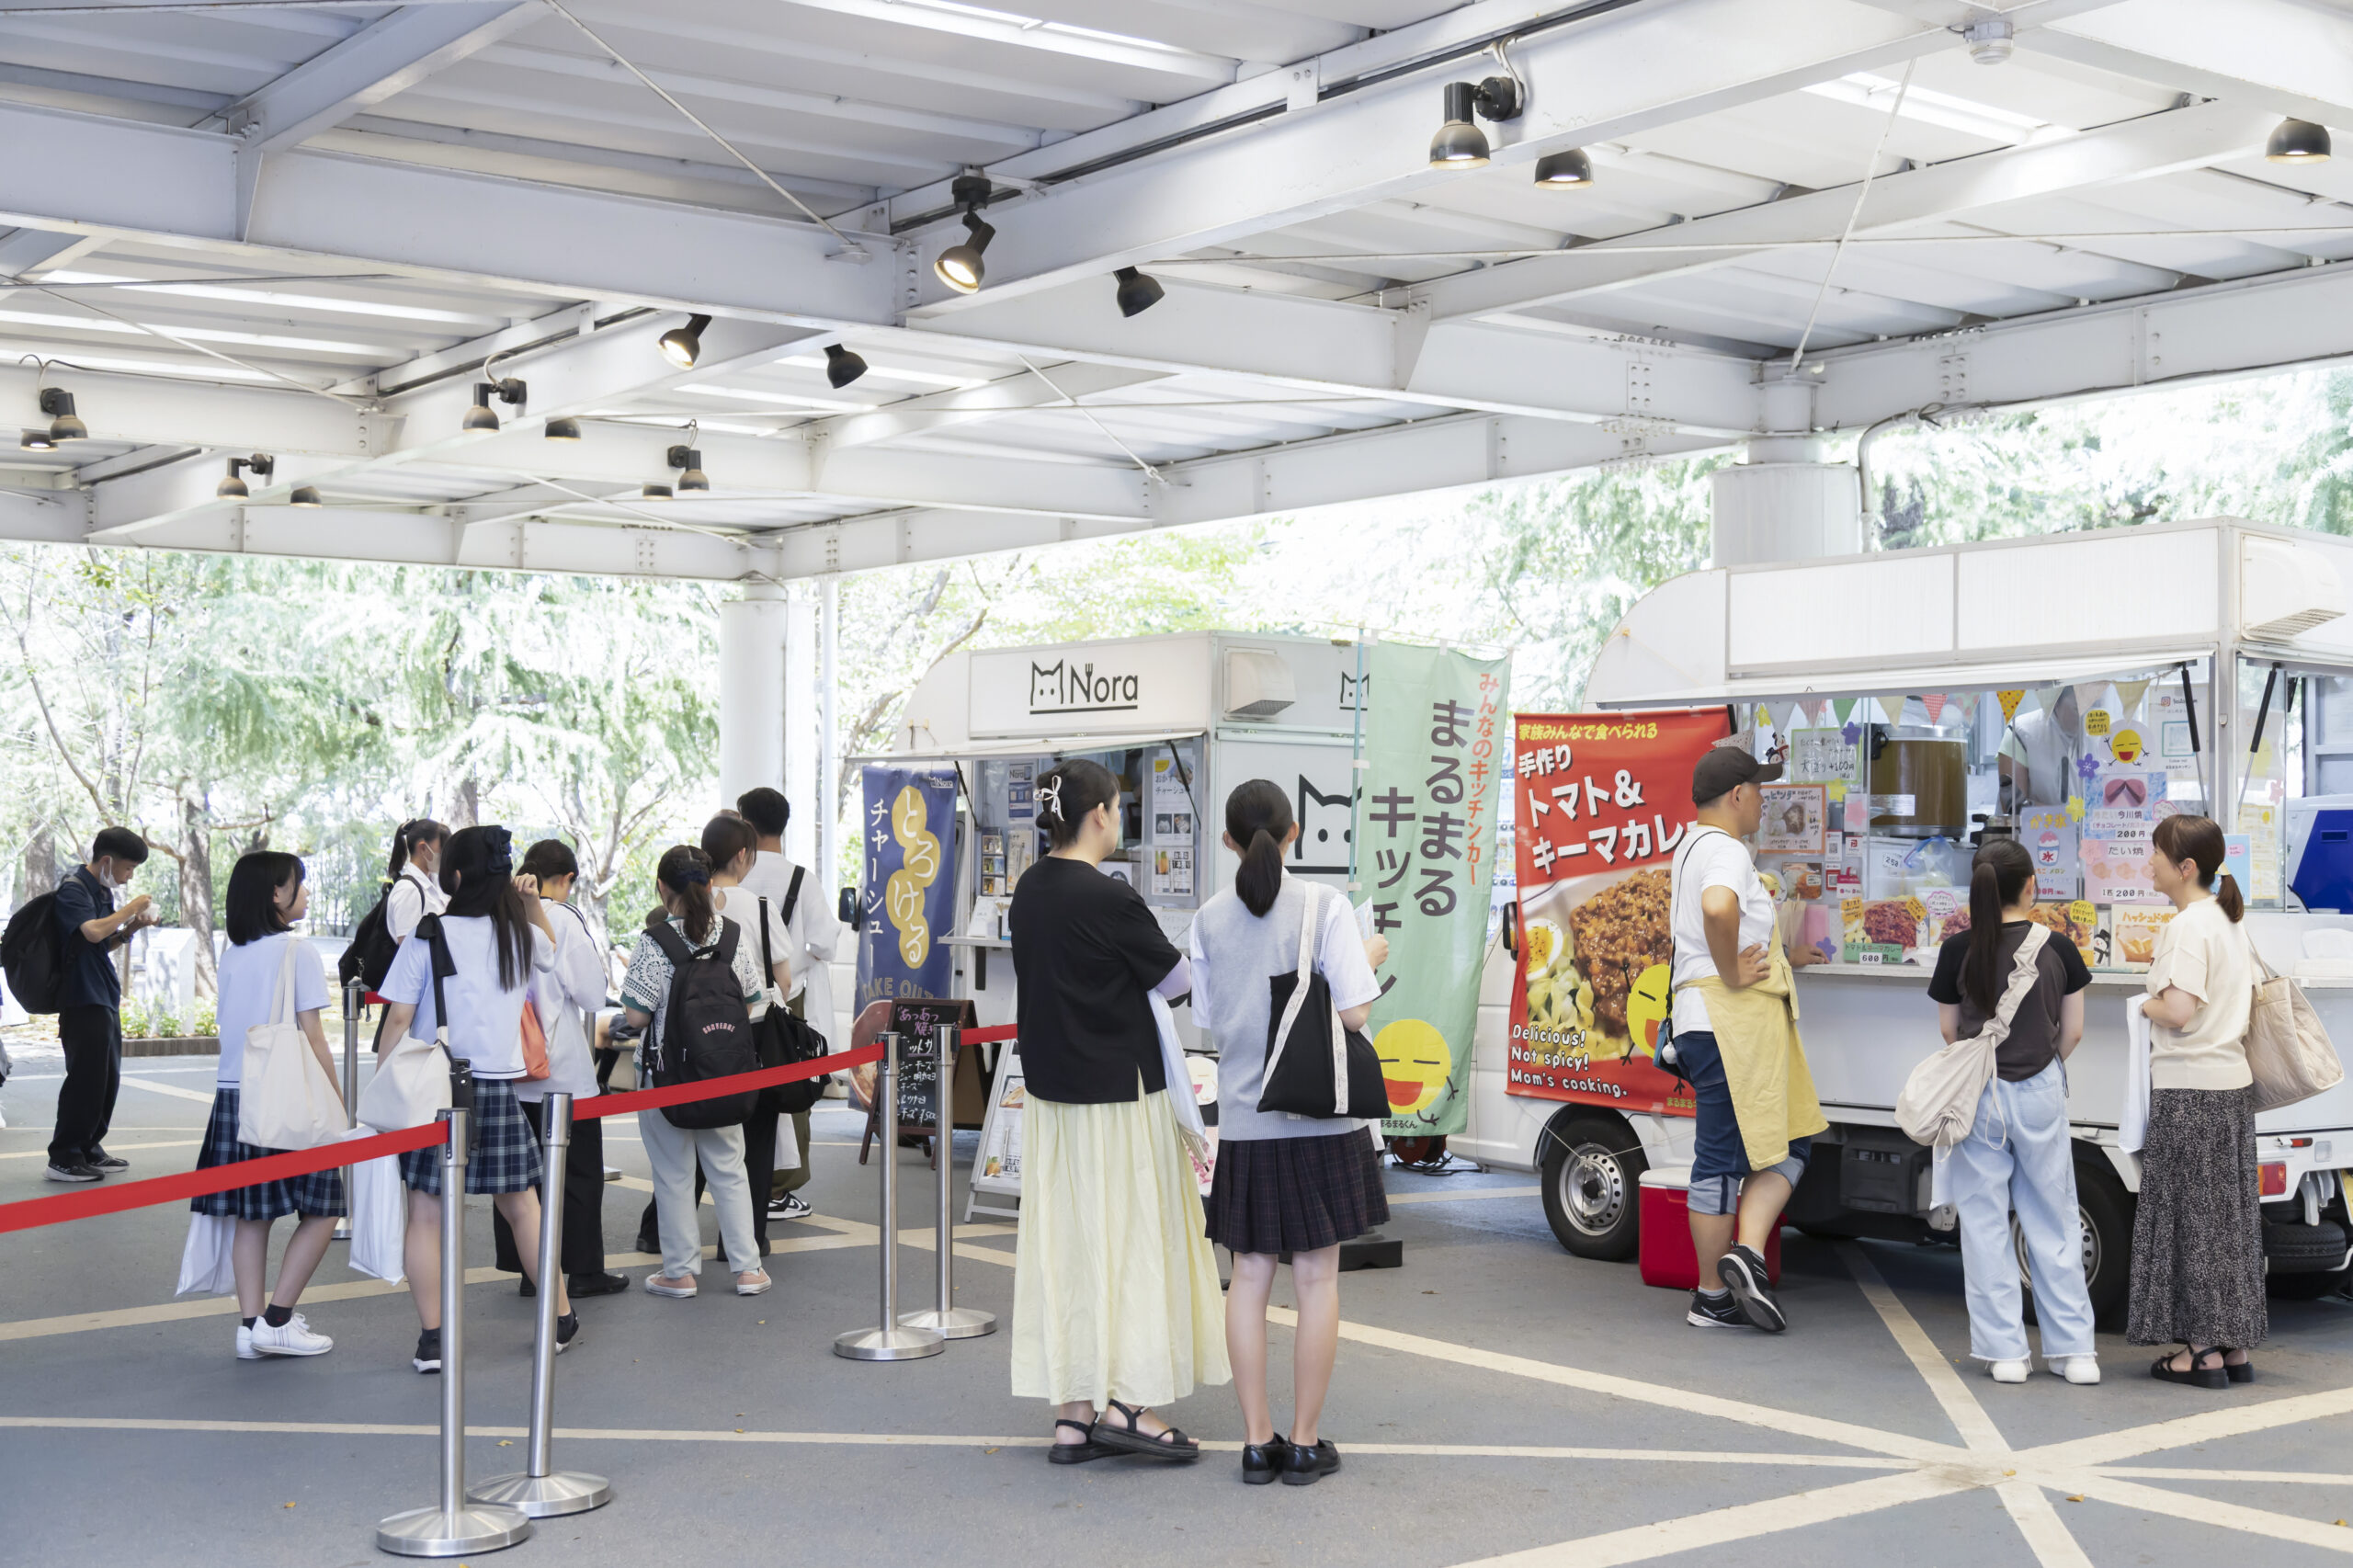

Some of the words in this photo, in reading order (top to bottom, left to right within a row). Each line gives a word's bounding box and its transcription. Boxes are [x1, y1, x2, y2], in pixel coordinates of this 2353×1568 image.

[1069, 662, 1139, 704] Nora
[1518, 722, 1659, 742] 家族みんなで食べられる
[1518, 744, 1573, 779] 手作り
[1154, 787, 1185, 795] チャーシュ
[1465, 672, 1501, 886] みんなのキッチンカー
[1413, 699, 1476, 917] まるまる
[1528, 768, 1647, 829] トマト&
[2029, 812, 2067, 830] かき氷
[2040, 850, 2054, 862] 氷
[867, 797, 889, 968] チャーシュー
[893, 789, 935, 963] とろける
[861, 977, 894, 1001] TAKE
[701, 1021, 736, 1035] CONVERSE
[1511, 1023, 1586, 1049] Delicious!
[1510, 1045, 1539, 1063] Not
[1543, 1051, 1590, 1073] spicy!
[1510, 1067, 1556, 1088] Mom's
[1562, 1076, 1629, 1099] cooking.
